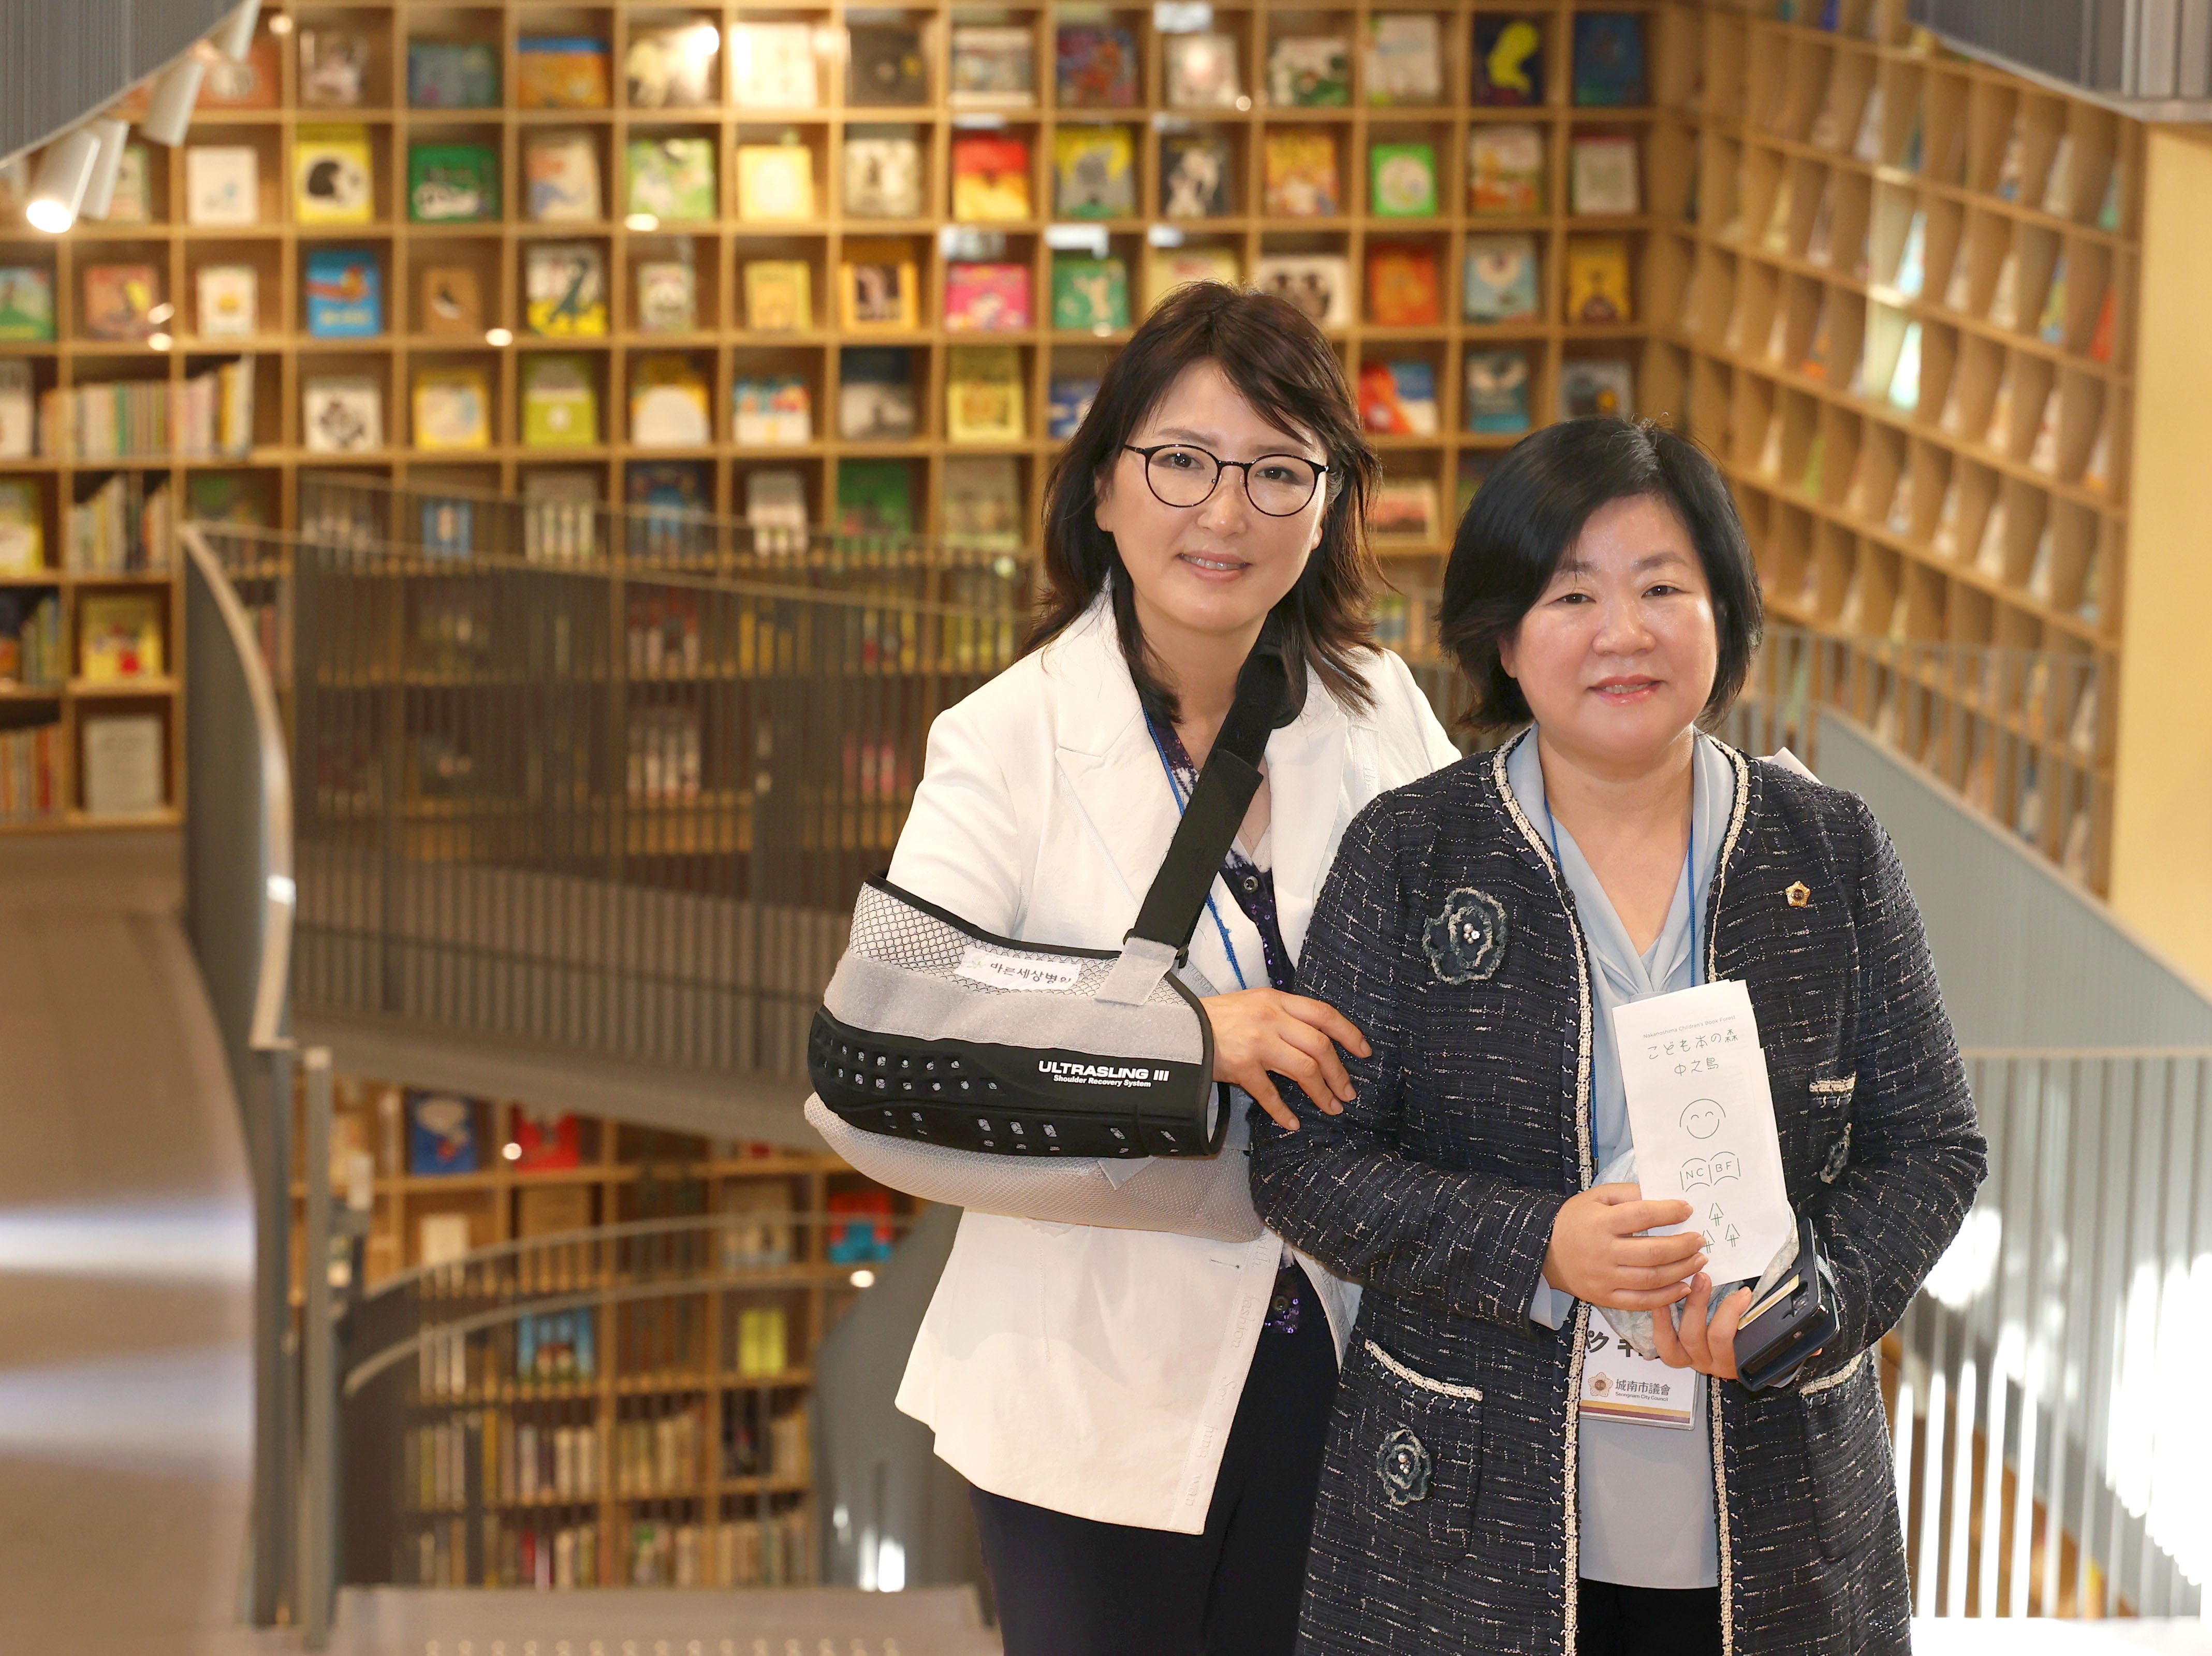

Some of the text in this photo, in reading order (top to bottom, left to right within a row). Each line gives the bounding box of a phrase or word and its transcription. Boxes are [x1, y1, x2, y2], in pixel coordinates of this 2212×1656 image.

[1643, 1028, 1677, 1039] Nakanoshima
[1678, 1022, 1704, 1032] Children's
[1648, 1029, 1738, 1059] こども本の森
[1038, 1060, 1170, 1082] ULTRASLING III
[1674, 1057, 1719, 1077] 中之島
[1053, 1074, 1151, 1088] Shoulder Recovery System
[1686, 1161, 1732, 1180] NC BF
[1615, 1378, 1671, 1396] 城南市議會
